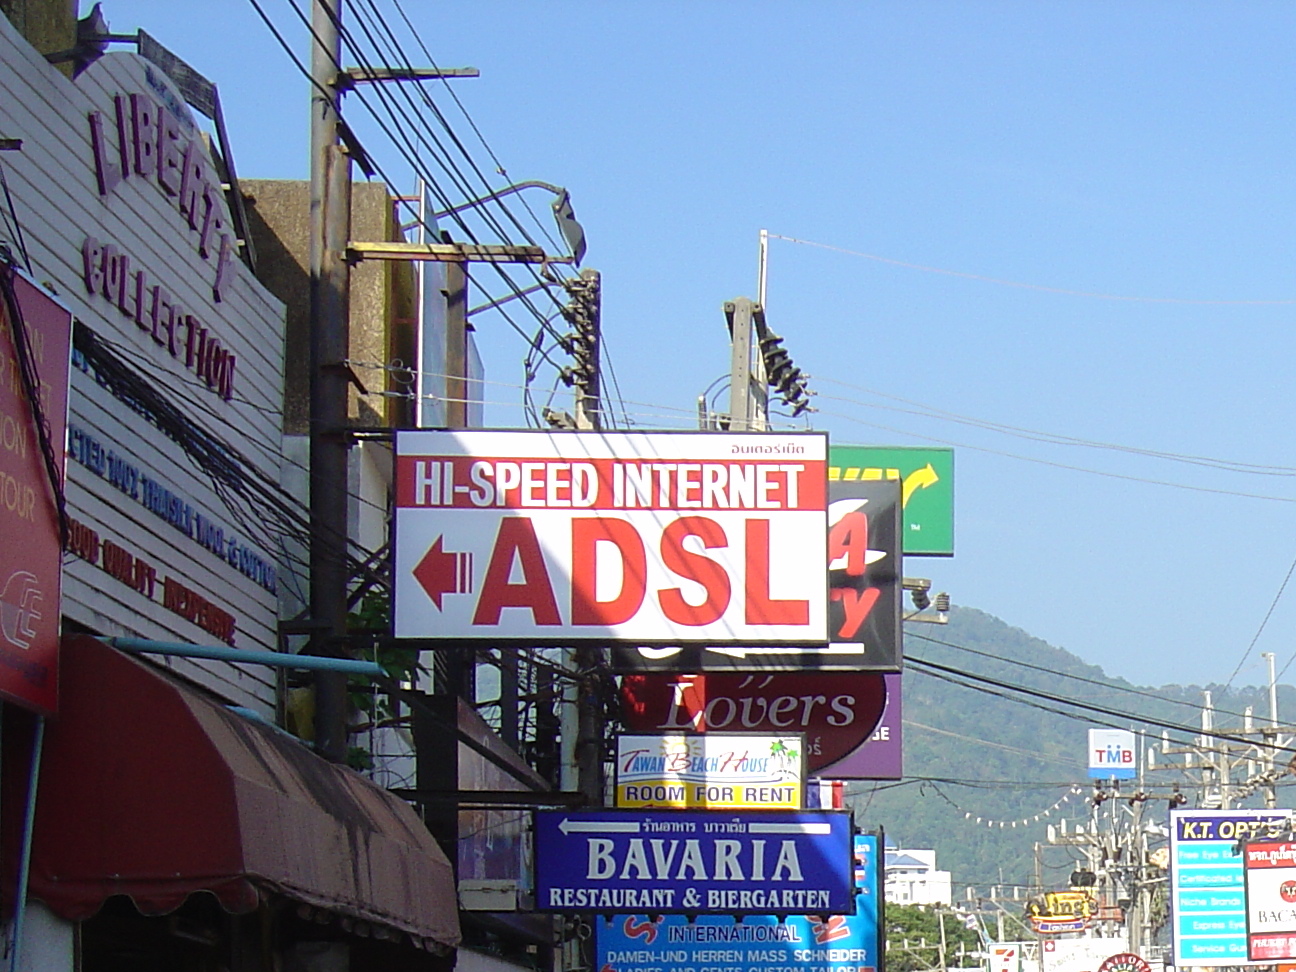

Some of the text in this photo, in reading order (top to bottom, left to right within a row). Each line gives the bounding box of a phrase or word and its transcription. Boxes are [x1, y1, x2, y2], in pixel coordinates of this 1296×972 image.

[89, 93, 239, 302] LIBERTY
[82, 236, 236, 401] COLLECTION
[415, 461, 805, 509] HI-SPEED INTERNET
[472, 516, 811, 626] ADSL
[657, 675, 857, 730] Lovers
[620, 750, 769, 773] TAWAN BEACH HOUSE
[1095, 749, 1133, 764] TMB
[626, 786, 795, 802] ROOM FOR RENT
[643, 818, 696, 833] ร้านอาหาร
[1183, 821, 1214, 839] K.T.
[586, 838, 804, 882] BAVARIA
[549, 888, 830, 909] RESTAURANT & BIERGARTEN
[668, 925, 801, 943] INTERNATIONAL
[607, 948, 867, 964] DAMEN-UND HERREN MASS SCHNEIDER
